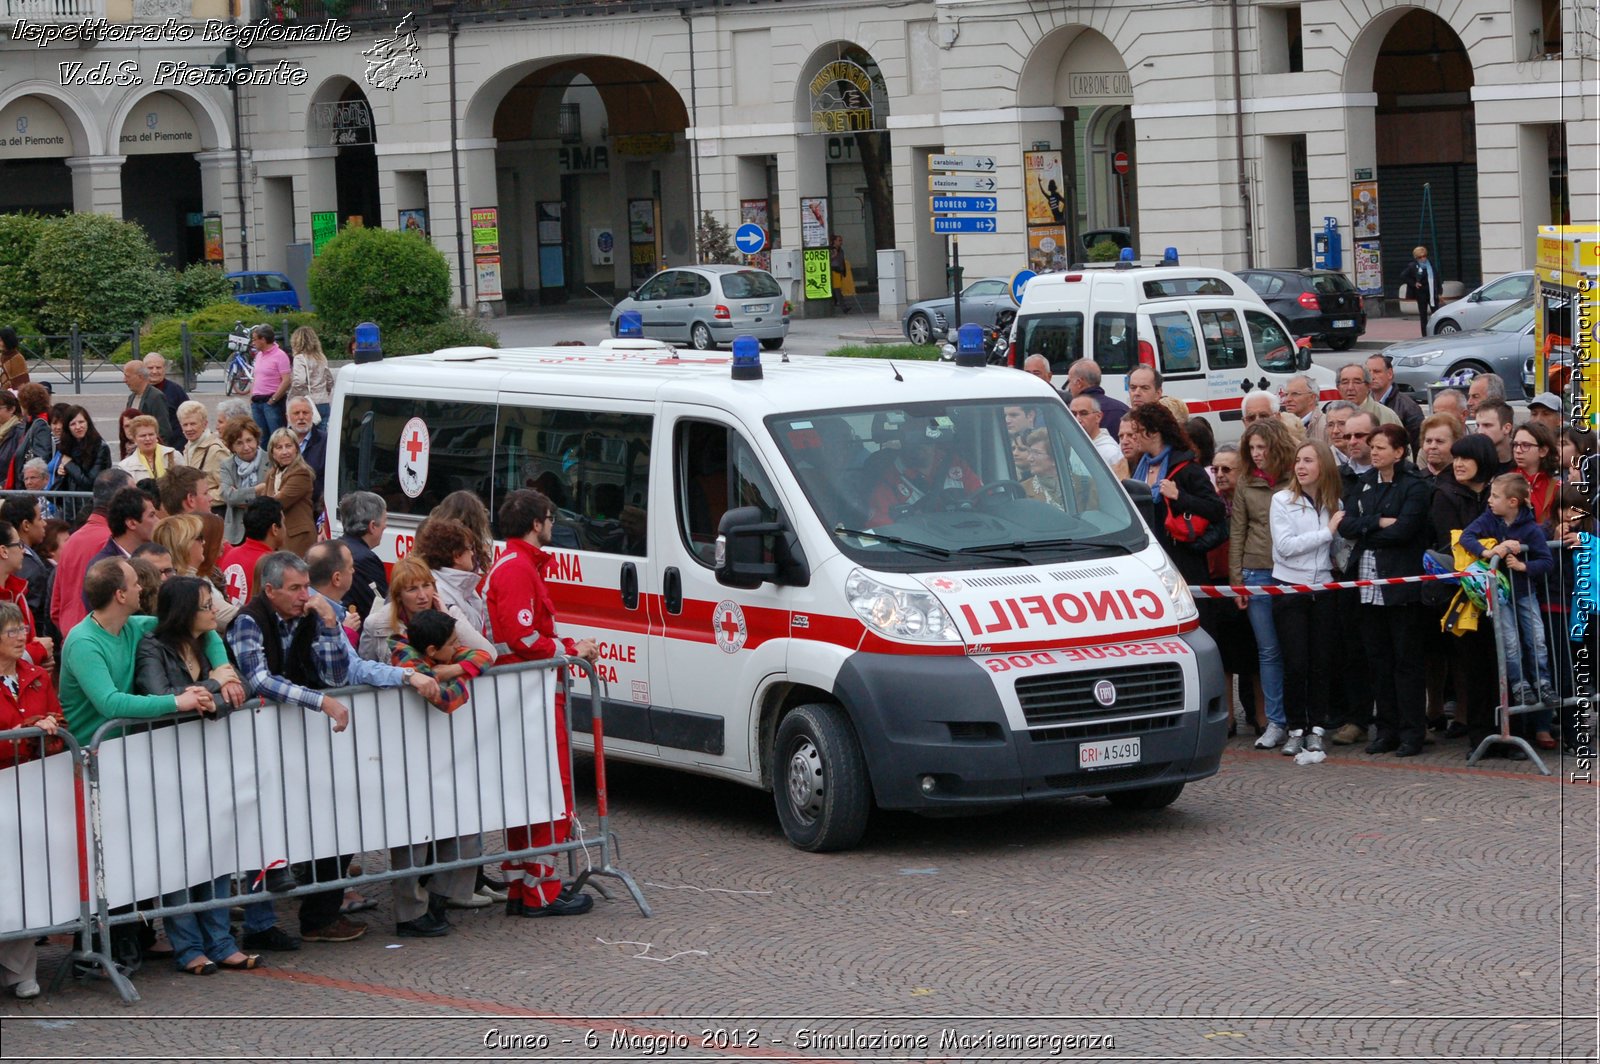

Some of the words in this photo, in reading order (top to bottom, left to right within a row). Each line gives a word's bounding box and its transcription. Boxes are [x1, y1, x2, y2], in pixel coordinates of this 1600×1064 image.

[811, 62, 870, 96] PASTIFICIO
[1073, 75, 1109, 95] CARBONE
[9, 136, 22, 146] del
[25, 135, 64, 145] Piemonte
[120, 134, 137, 142] anca
[139, 132, 153, 141] del
[155, 130, 193, 141] Piemonte
[933, 159, 964, 167] carabinieri
[934, 200, 967, 208] DRONERO
[975, 200, 985, 208] 20
[936, 221, 962, 229] TORINO
[804, 250, 829, 261] CORSI
[547, 551, 583, 583] ANA
[599, 641, 636, 664] CALE
[1099, 687, 1112, 700] FIAT
[1081, 747, 1098, 763] CRI
[1104, 743, 1139, 761] A549D
